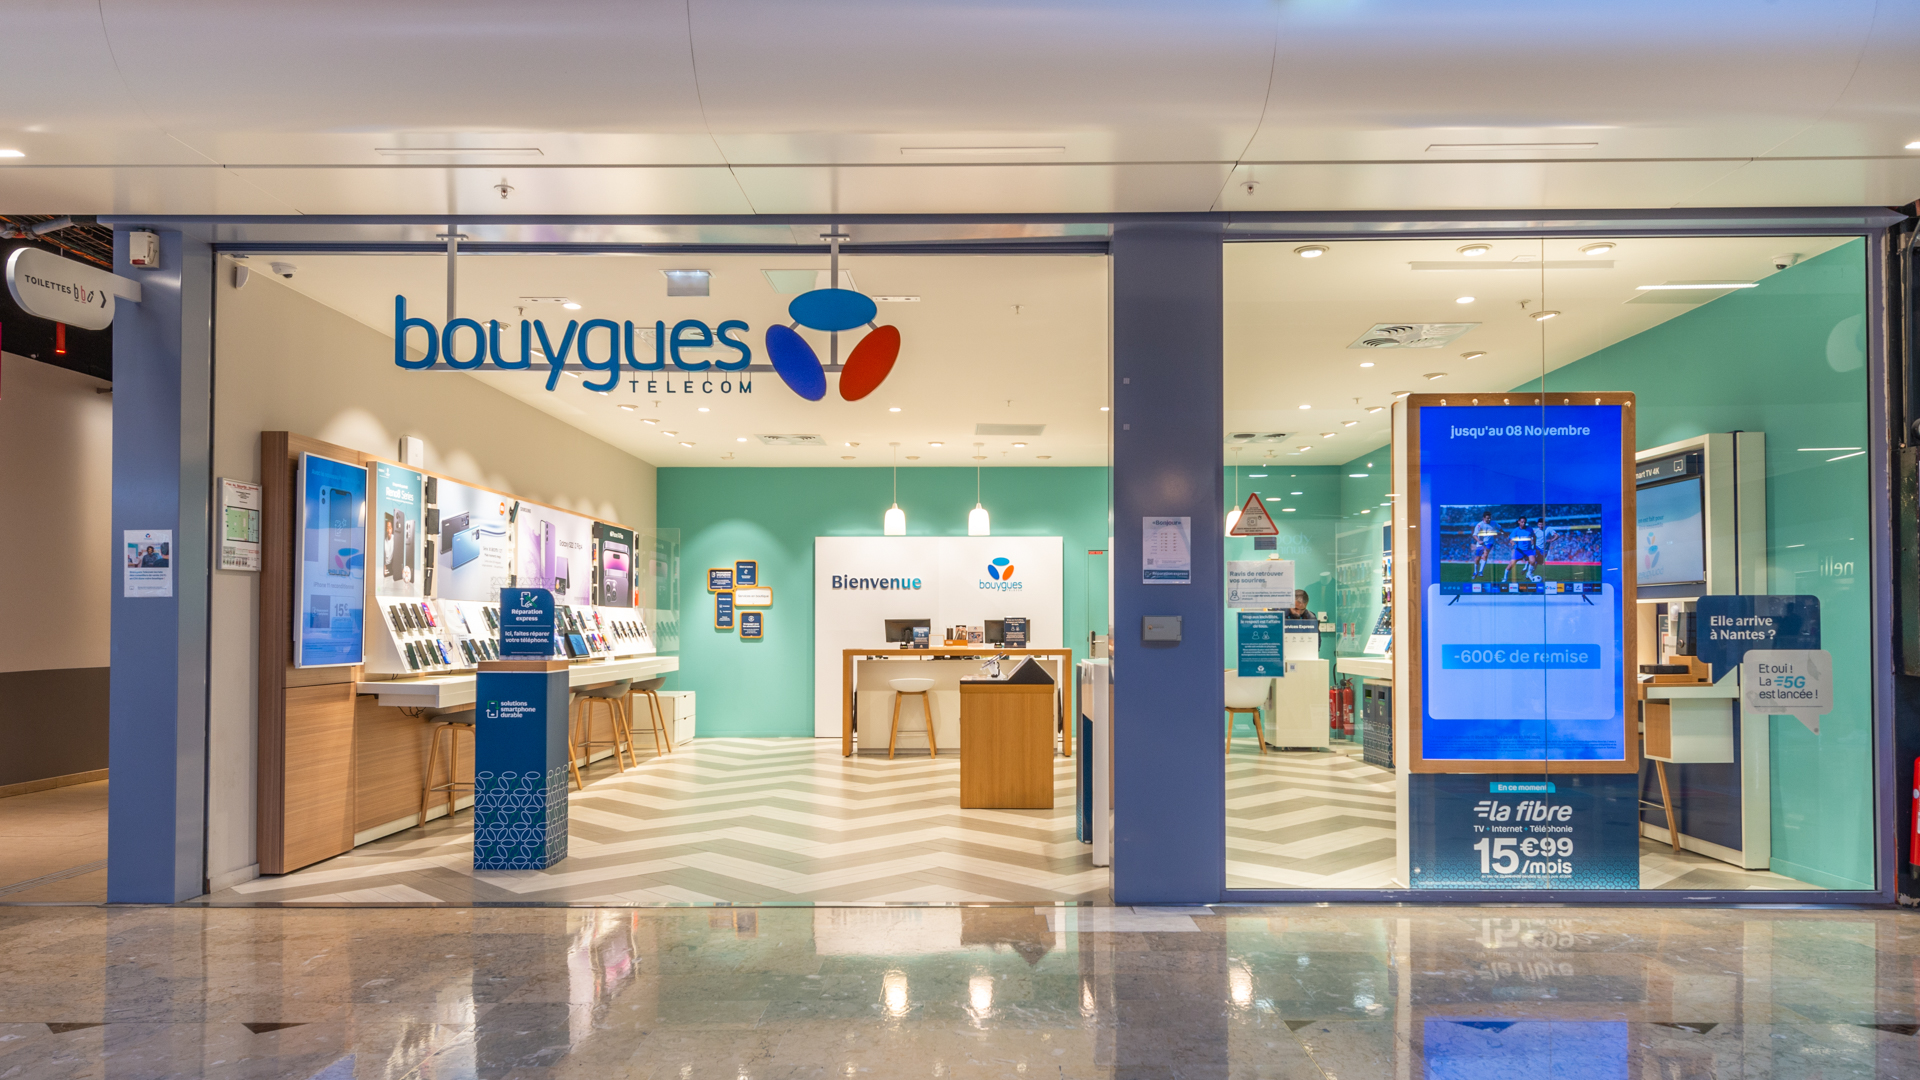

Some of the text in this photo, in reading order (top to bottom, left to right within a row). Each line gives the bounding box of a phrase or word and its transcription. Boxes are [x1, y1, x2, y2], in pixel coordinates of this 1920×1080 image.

[24, 274, 71, 294] TOILETTES
[395, 295, 752, 391] bouygues
[629, 380, 752, 394] TELECOM
[1450, 424, 1590, 439] jusqu'au 08 Novembre
[832, 574, 921, 589] Bienvenue
[979, 579, 1022, 591] bouygues
[1710, 615, 1773, 626] Elle arrive
[1710, 629, 1776, 640] à Nantes ?
[1454, 650, 1588, 663] -600€ de remise
[1759, 664, 1793, 673] Et oui !
[1759, 676, 1806, 688] La 5G
[1759, 689, 1818, 699] est lancée !
[1489, 801, 1573, 821] la fibre
[1522, 859, 1572, 874] /mois
